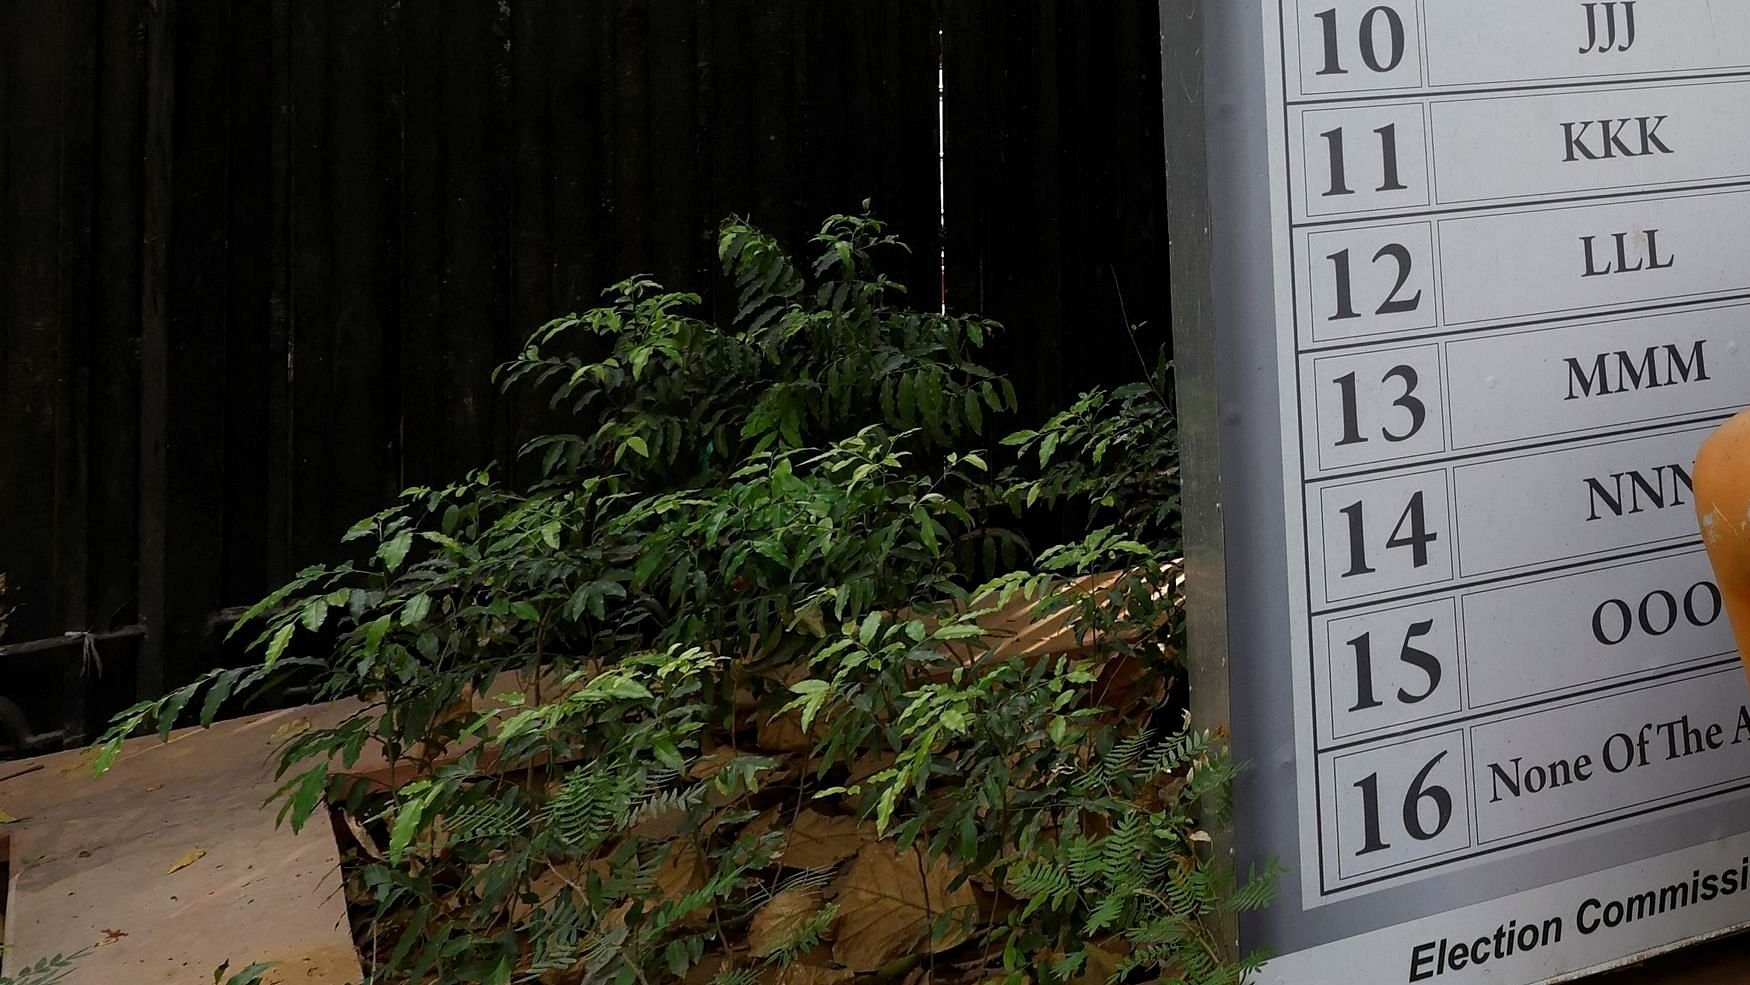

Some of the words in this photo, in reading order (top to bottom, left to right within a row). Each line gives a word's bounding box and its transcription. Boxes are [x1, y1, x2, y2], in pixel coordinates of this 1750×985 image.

[1314, 6, 1404, 75] 10
[1579, 1, 1636, 54] JJJ
[1320, 123, 1407, 196] 11
[1560, 115, 1674, 162] KKK
[1326, 244, 1421, 320] 12
[1579, 229, 1674, 277] LLL
[1333, 365, 1425, 446] 13
[1564, 340, 1711, 400] MMM
[1340, 491, 1437, 578] 14
[1347, 619, 1441, 712] 15
[1592, 581, 1721, 645] OOO
[1354, 750, 1452, 856] 16
[1487, 757, 1592, 803] None
[1602, 723, 1652, 773] Of
[1656, 715, 1724, 760] The
[1408, 916, 1562, 983] Election
